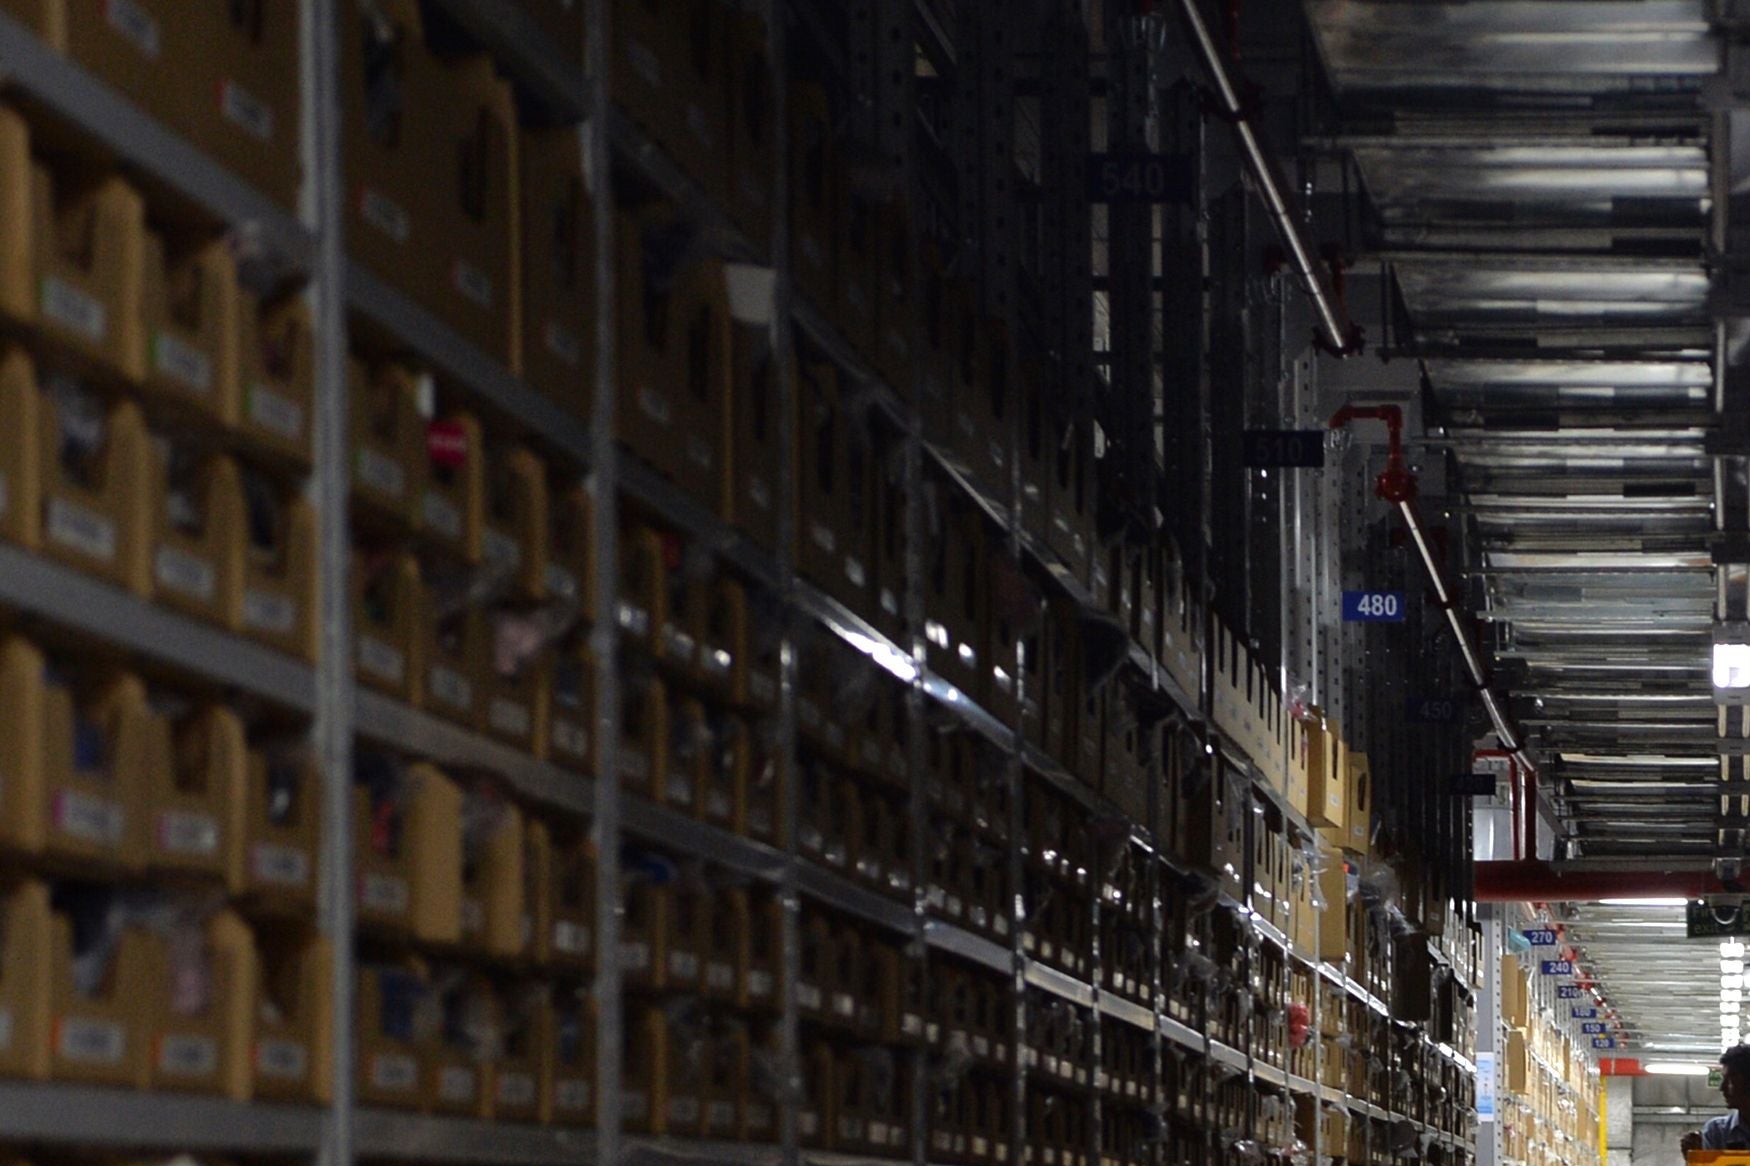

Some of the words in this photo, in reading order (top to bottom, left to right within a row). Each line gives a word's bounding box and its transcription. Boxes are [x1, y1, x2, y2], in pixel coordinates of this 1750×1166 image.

[1101, 161, 1164, 196] 540
[1255, 438, 1303, 463] 510
[1357, 594, 1397, 616] 480
[1419, 701, 1453, 720] 450
[1531, 932, 1553, 943] 270
[1549, 962, 1569, 973] 240
[1560, 987, 1577, 998] 210
[1585, 1024, 1601, 1033] 150
[1595, 1039, 1610, 1048] 120
